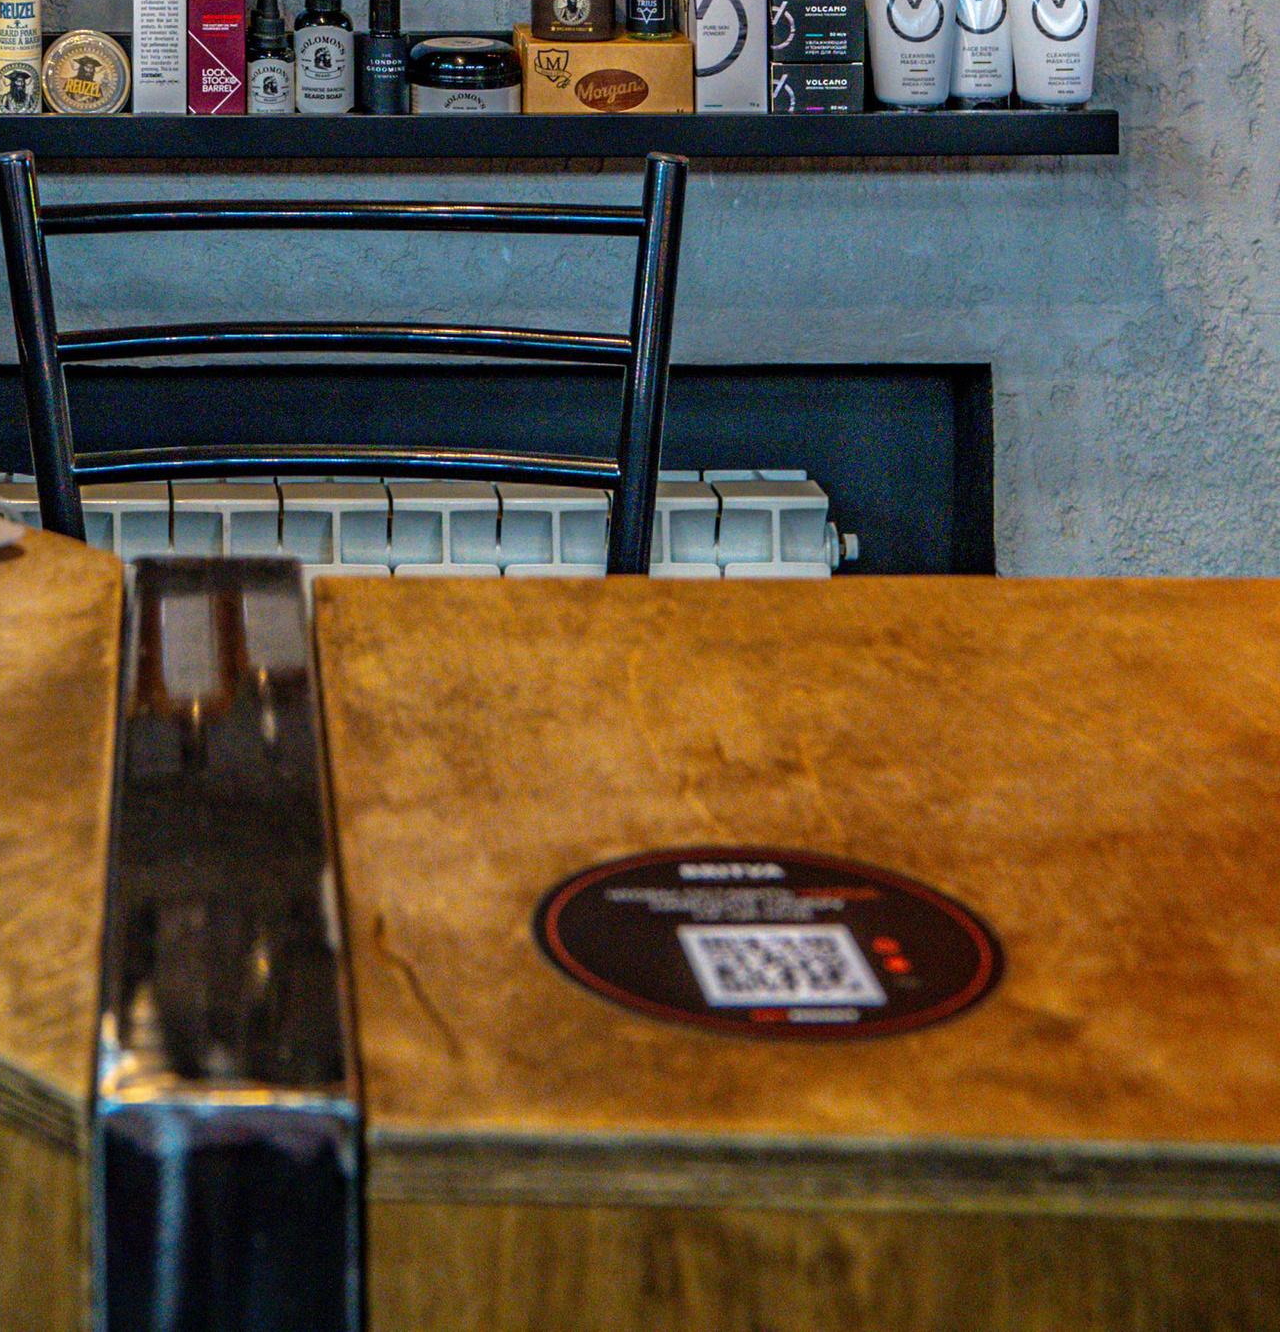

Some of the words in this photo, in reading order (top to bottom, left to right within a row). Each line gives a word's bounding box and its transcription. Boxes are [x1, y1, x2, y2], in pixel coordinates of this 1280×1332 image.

[0, 2, 35, 19] REUZEL
[202, 69, 226, 77] LOCK
[66, 78, 101, 97] REUZEL
[202, 84, 233, 93] BARREL
